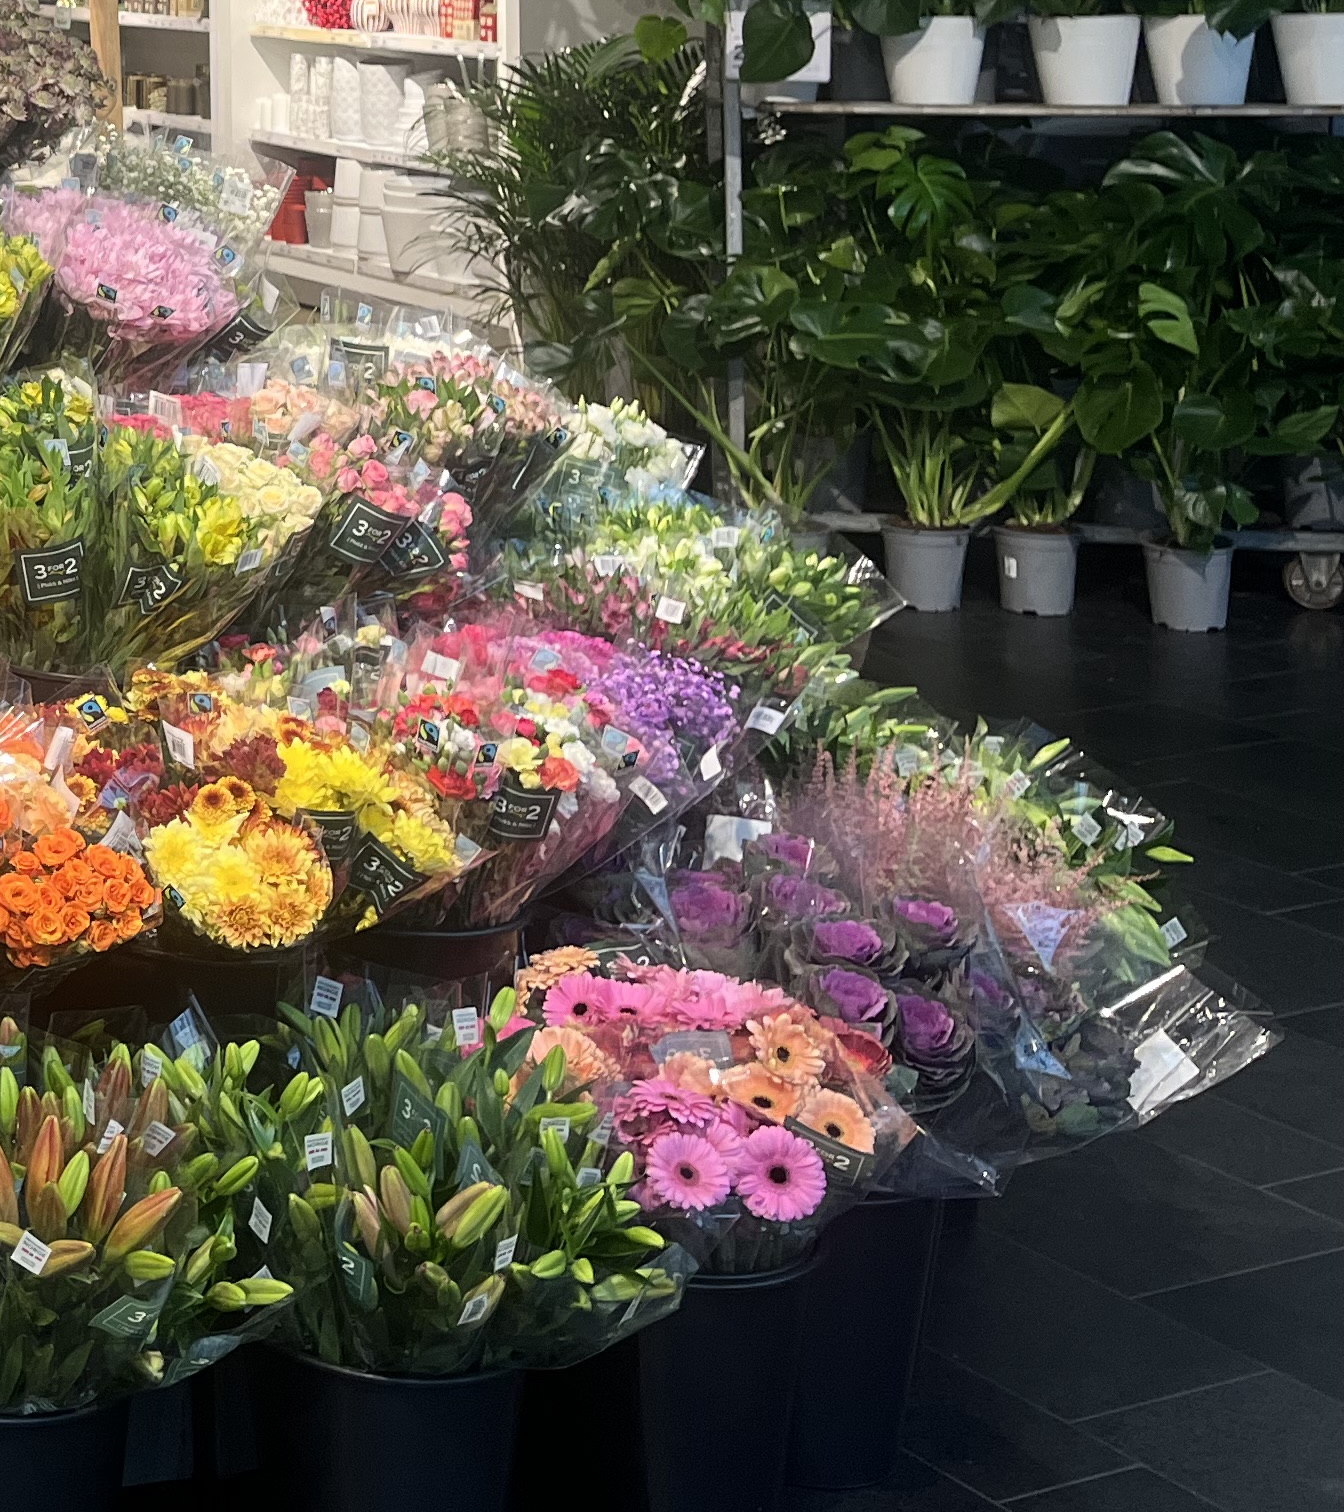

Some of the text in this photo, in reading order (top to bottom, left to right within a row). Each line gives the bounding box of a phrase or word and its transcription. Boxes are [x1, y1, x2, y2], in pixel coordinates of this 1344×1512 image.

[352, 519, 369, 536] 3
[377, 530, 391, 545] 2
[34, 558, 78, 579] 3 FOR 2
[508, 803, 527, 813] FOR
[526, 805, 541, 820] 2
[363, 856, 380, 871] 3
[387, 880, 404, 897] 2
[833, 1155, 850, 1171] 2
